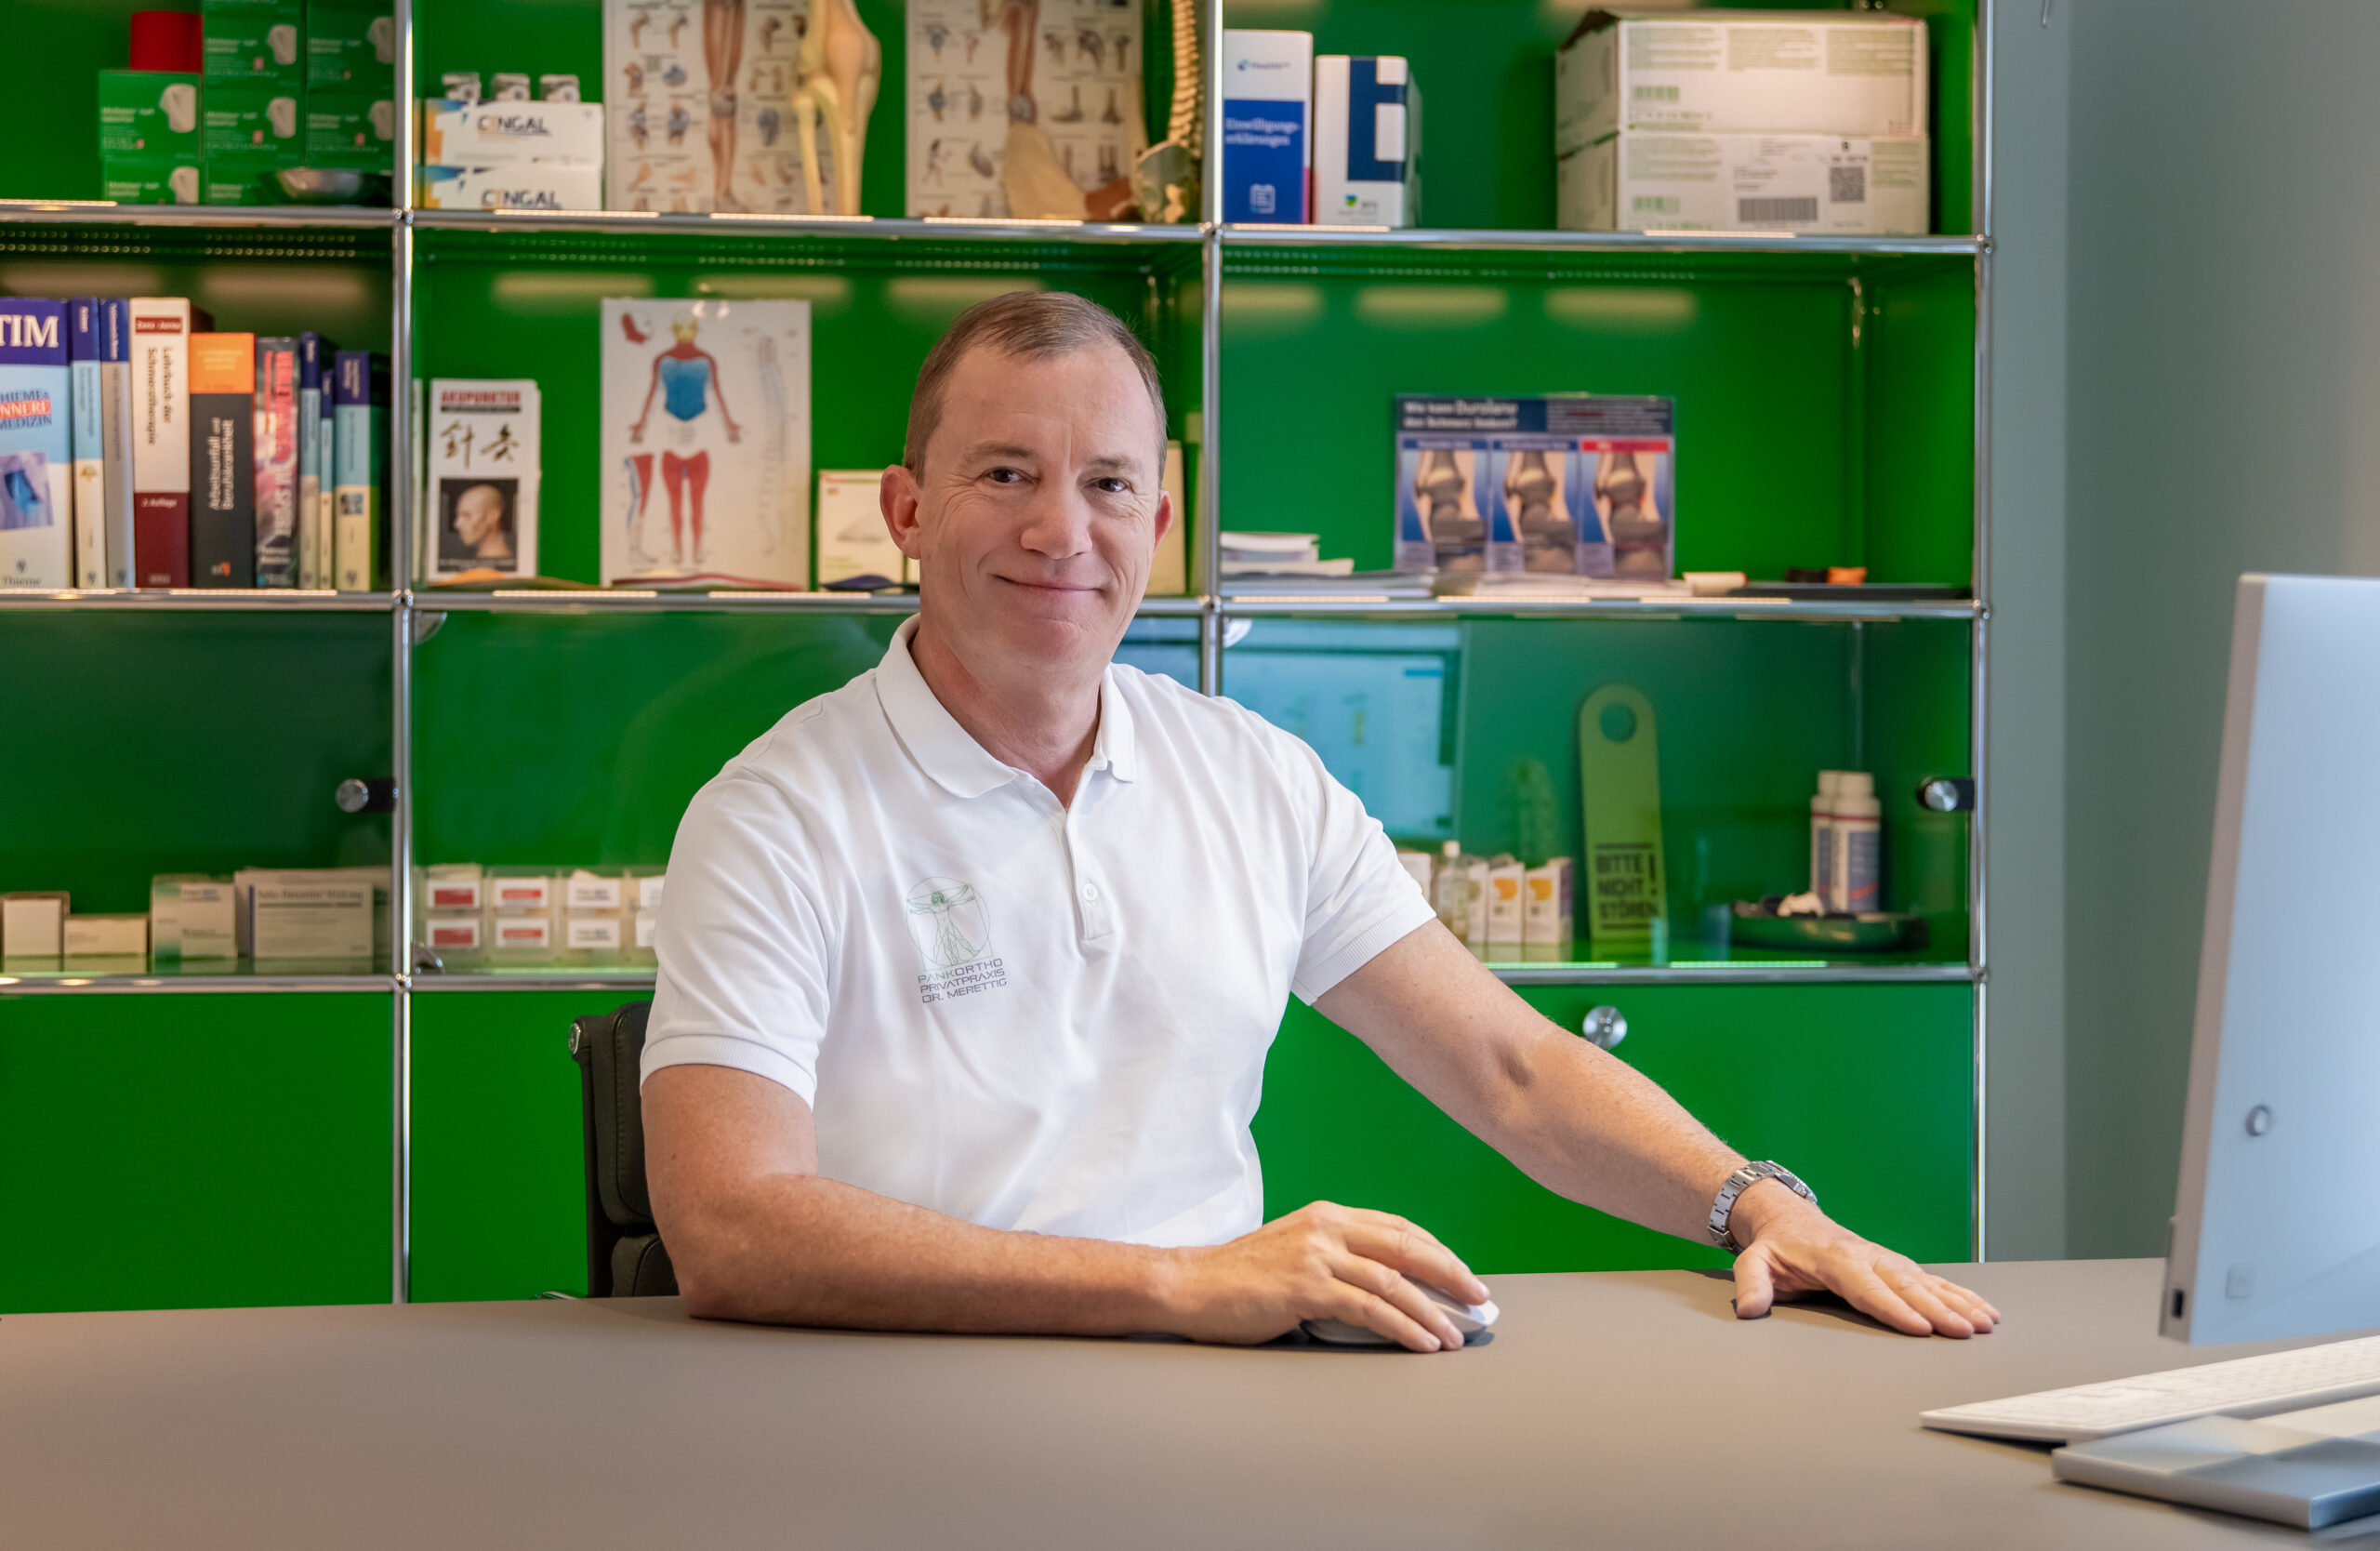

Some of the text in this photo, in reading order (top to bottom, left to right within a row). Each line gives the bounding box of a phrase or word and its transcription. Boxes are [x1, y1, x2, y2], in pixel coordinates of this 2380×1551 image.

[478, 115, 549, 134] CINGAL
[482, 190, 561, 207] CINGAL
[0, 314, 59, 348] TIM
[163, 347, 173, 403] Lehrbuch
[0, 388, 50, 403] HIEMEs
[0, 400, 50, 418] NNERE
[1596, 854, 1643, 873] BITTE
[1597, 877, 1644, 896] NICHT
[1599, 898, 1659, 920] STÖREN
[918, 958, 1003, 984] PANKORTHO
[920, 968, 1006, 993] PRIVATPRAXIS
[922, 993, 945, 1004] DR.
